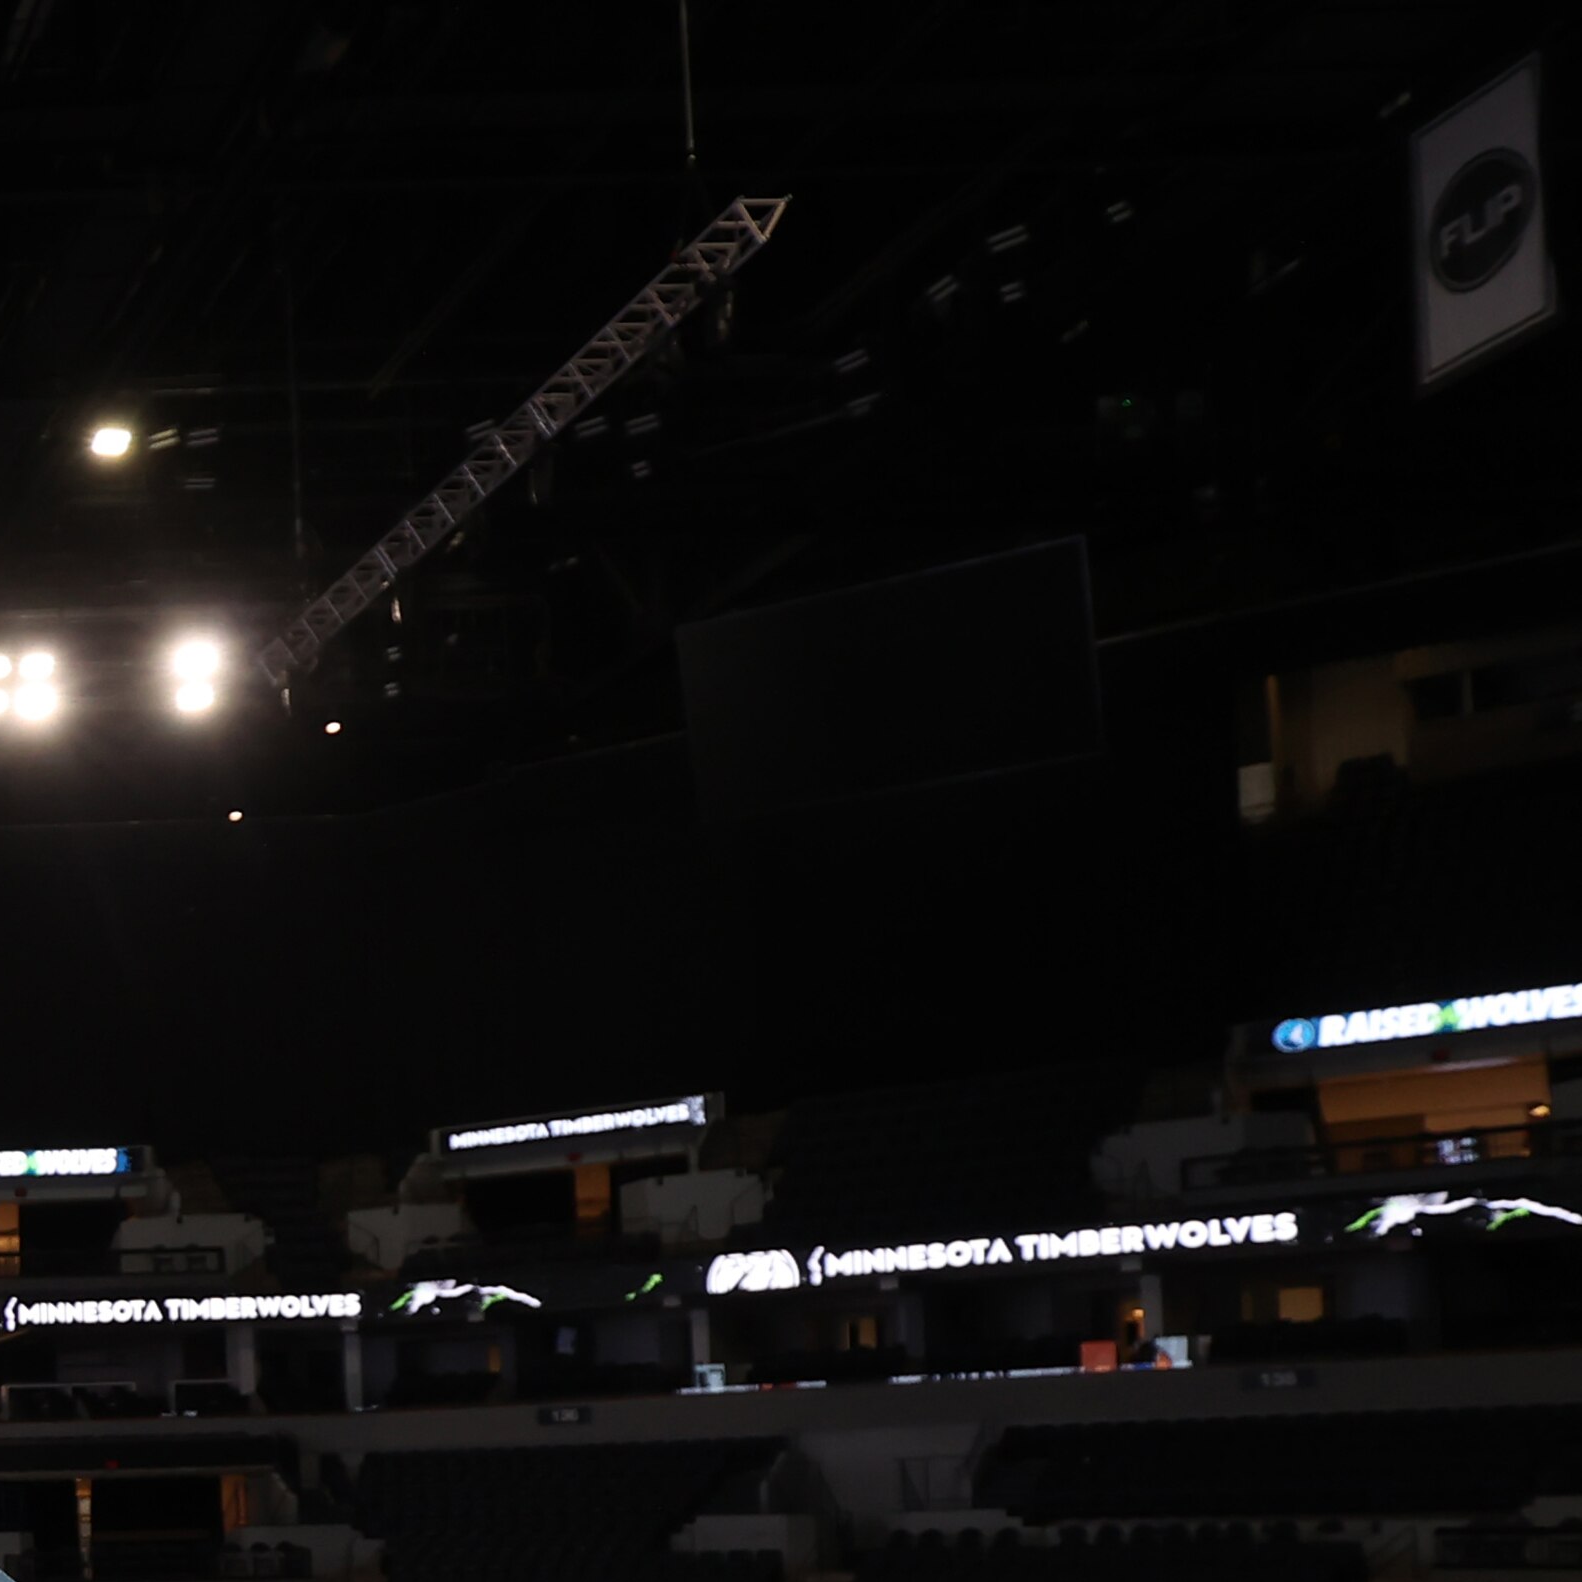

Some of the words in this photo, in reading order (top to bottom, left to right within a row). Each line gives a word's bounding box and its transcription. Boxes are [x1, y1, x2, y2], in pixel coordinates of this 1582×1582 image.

[1319, 1003, 1442, 1046] RAISED
[448, 1123, 550, 1150] MINNESOTA
[549, 1102, 691, 1138] TIMBERWOLVES
[32, 1148, 117, 1176] WOLVES
[824, 1237, 1014, 1278] MINNESOTA
[1015, 1212, 1299, 1262] TIMBERWOLVES
[18, 1299, 164, 1326] MINNESOTA
[165, 1292, 363, 1321] TIMBERWOLVES
